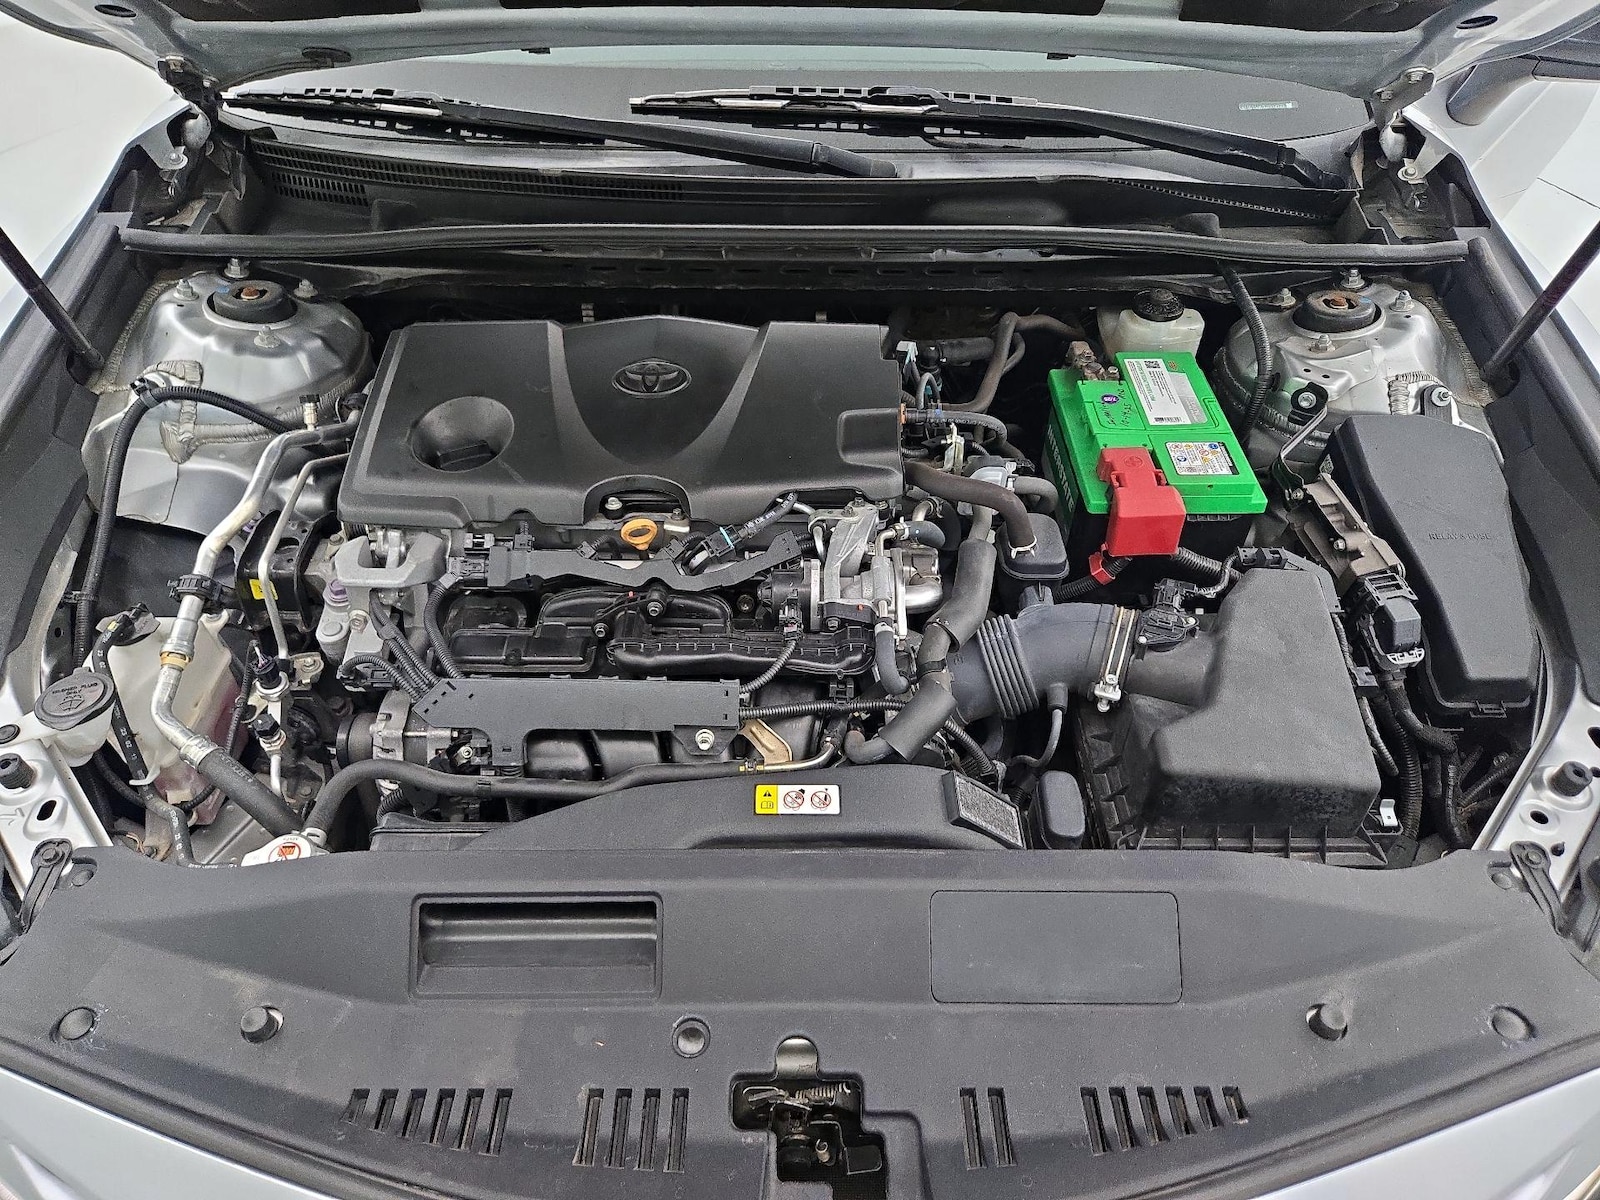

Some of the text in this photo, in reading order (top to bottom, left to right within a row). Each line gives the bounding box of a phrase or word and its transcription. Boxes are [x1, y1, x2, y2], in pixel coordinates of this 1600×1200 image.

[1048, 424, 1074, 512] INTERSTATE
[1428, 532, 1458, 540] RELAY
[120, 727, 127, 736] 23
[125, 740, 132, 748] 02
